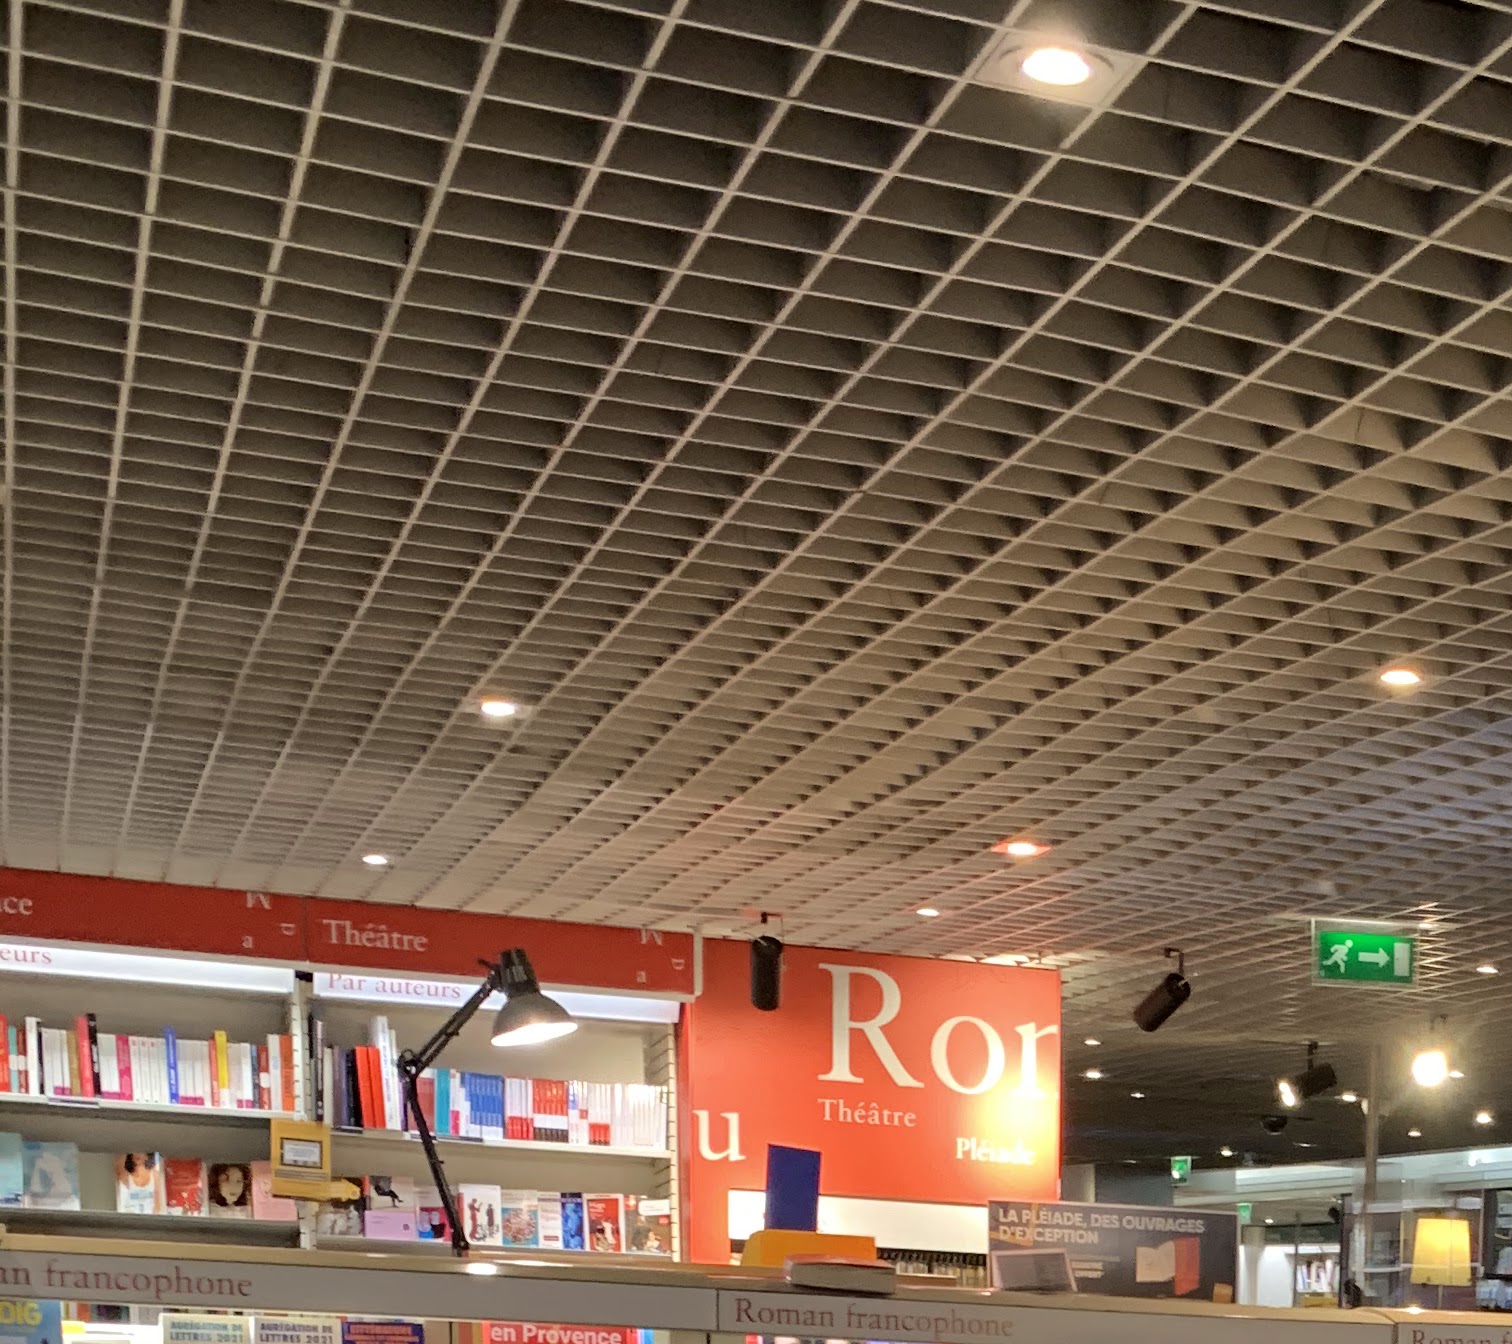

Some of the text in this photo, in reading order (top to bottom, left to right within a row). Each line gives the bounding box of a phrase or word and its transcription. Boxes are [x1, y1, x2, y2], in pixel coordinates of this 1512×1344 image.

[323, 918, 428, 953] Théâtre
[328, 971, 462, 999] Par auteurs
[818, 1098, 916, 1129] Théâtre
[956, 1137, 1034, 1166] Pléiade
[999, 1206, 1205, 1234] LA PLÉIADE, DES OUVRAGES
[999, 1225, 1099, 1246] D'EXCEPTION
[47, 1258, 252, 1298] francophone
[322, 1325, 333, 1333] DE
[736, 1297, 1014, 1342] Roman francophone
[170, 1333, 243, 1343] LETTRES 2021
[260, 1334, 333, 1344] LETTRES 2021
[491, 1327, 516, 1342] en
